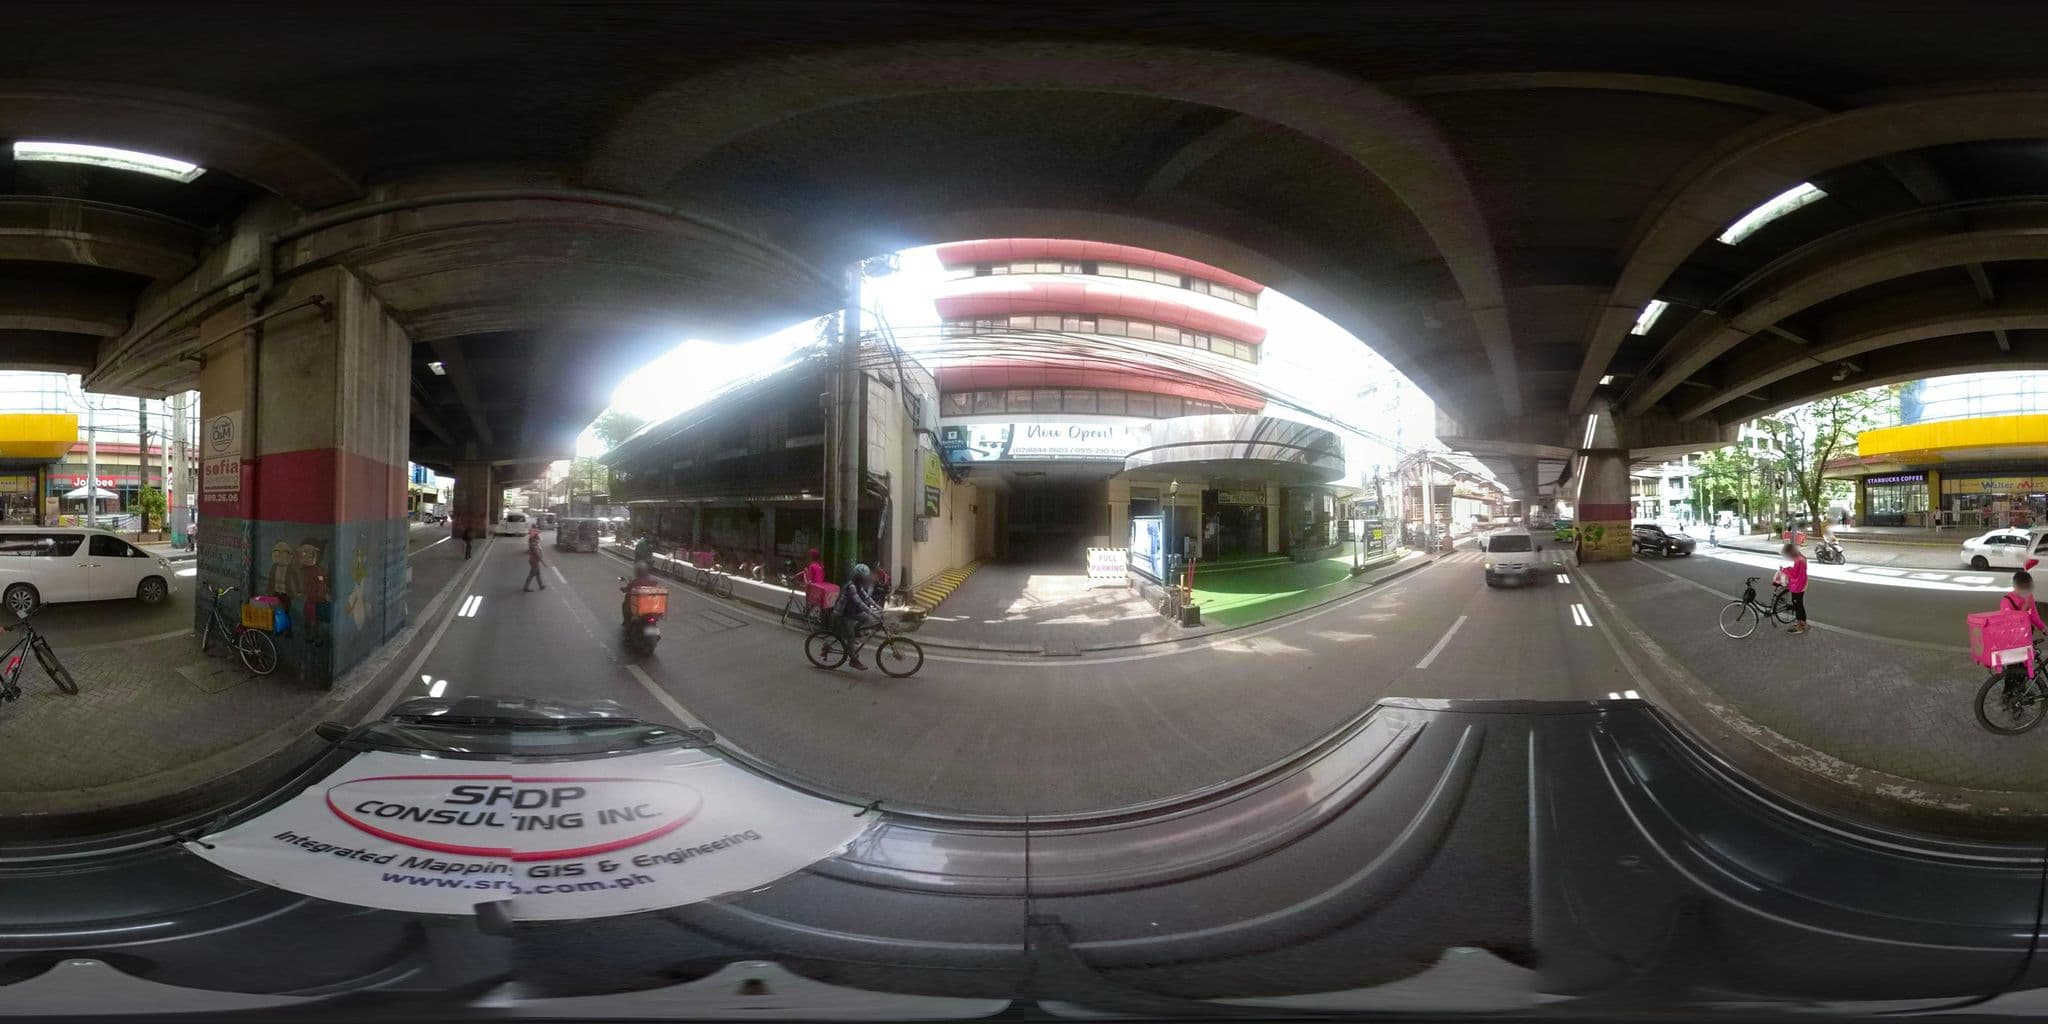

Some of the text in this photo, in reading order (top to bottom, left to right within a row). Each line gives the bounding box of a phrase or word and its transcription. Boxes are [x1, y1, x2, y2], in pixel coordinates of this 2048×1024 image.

[1027, 424, 1060, 438] Now
[205, 459, 239, 475] sofia
[1867, 476, 1900, 484] STARBUCKS
[597, 803, 663, 825] INC.
[273, 830, 398, 865] Integrated
[527, 862, 585, 878] GIS
[599, 860, 620, 873] &
[632, 828, 762, 868] Engineering
